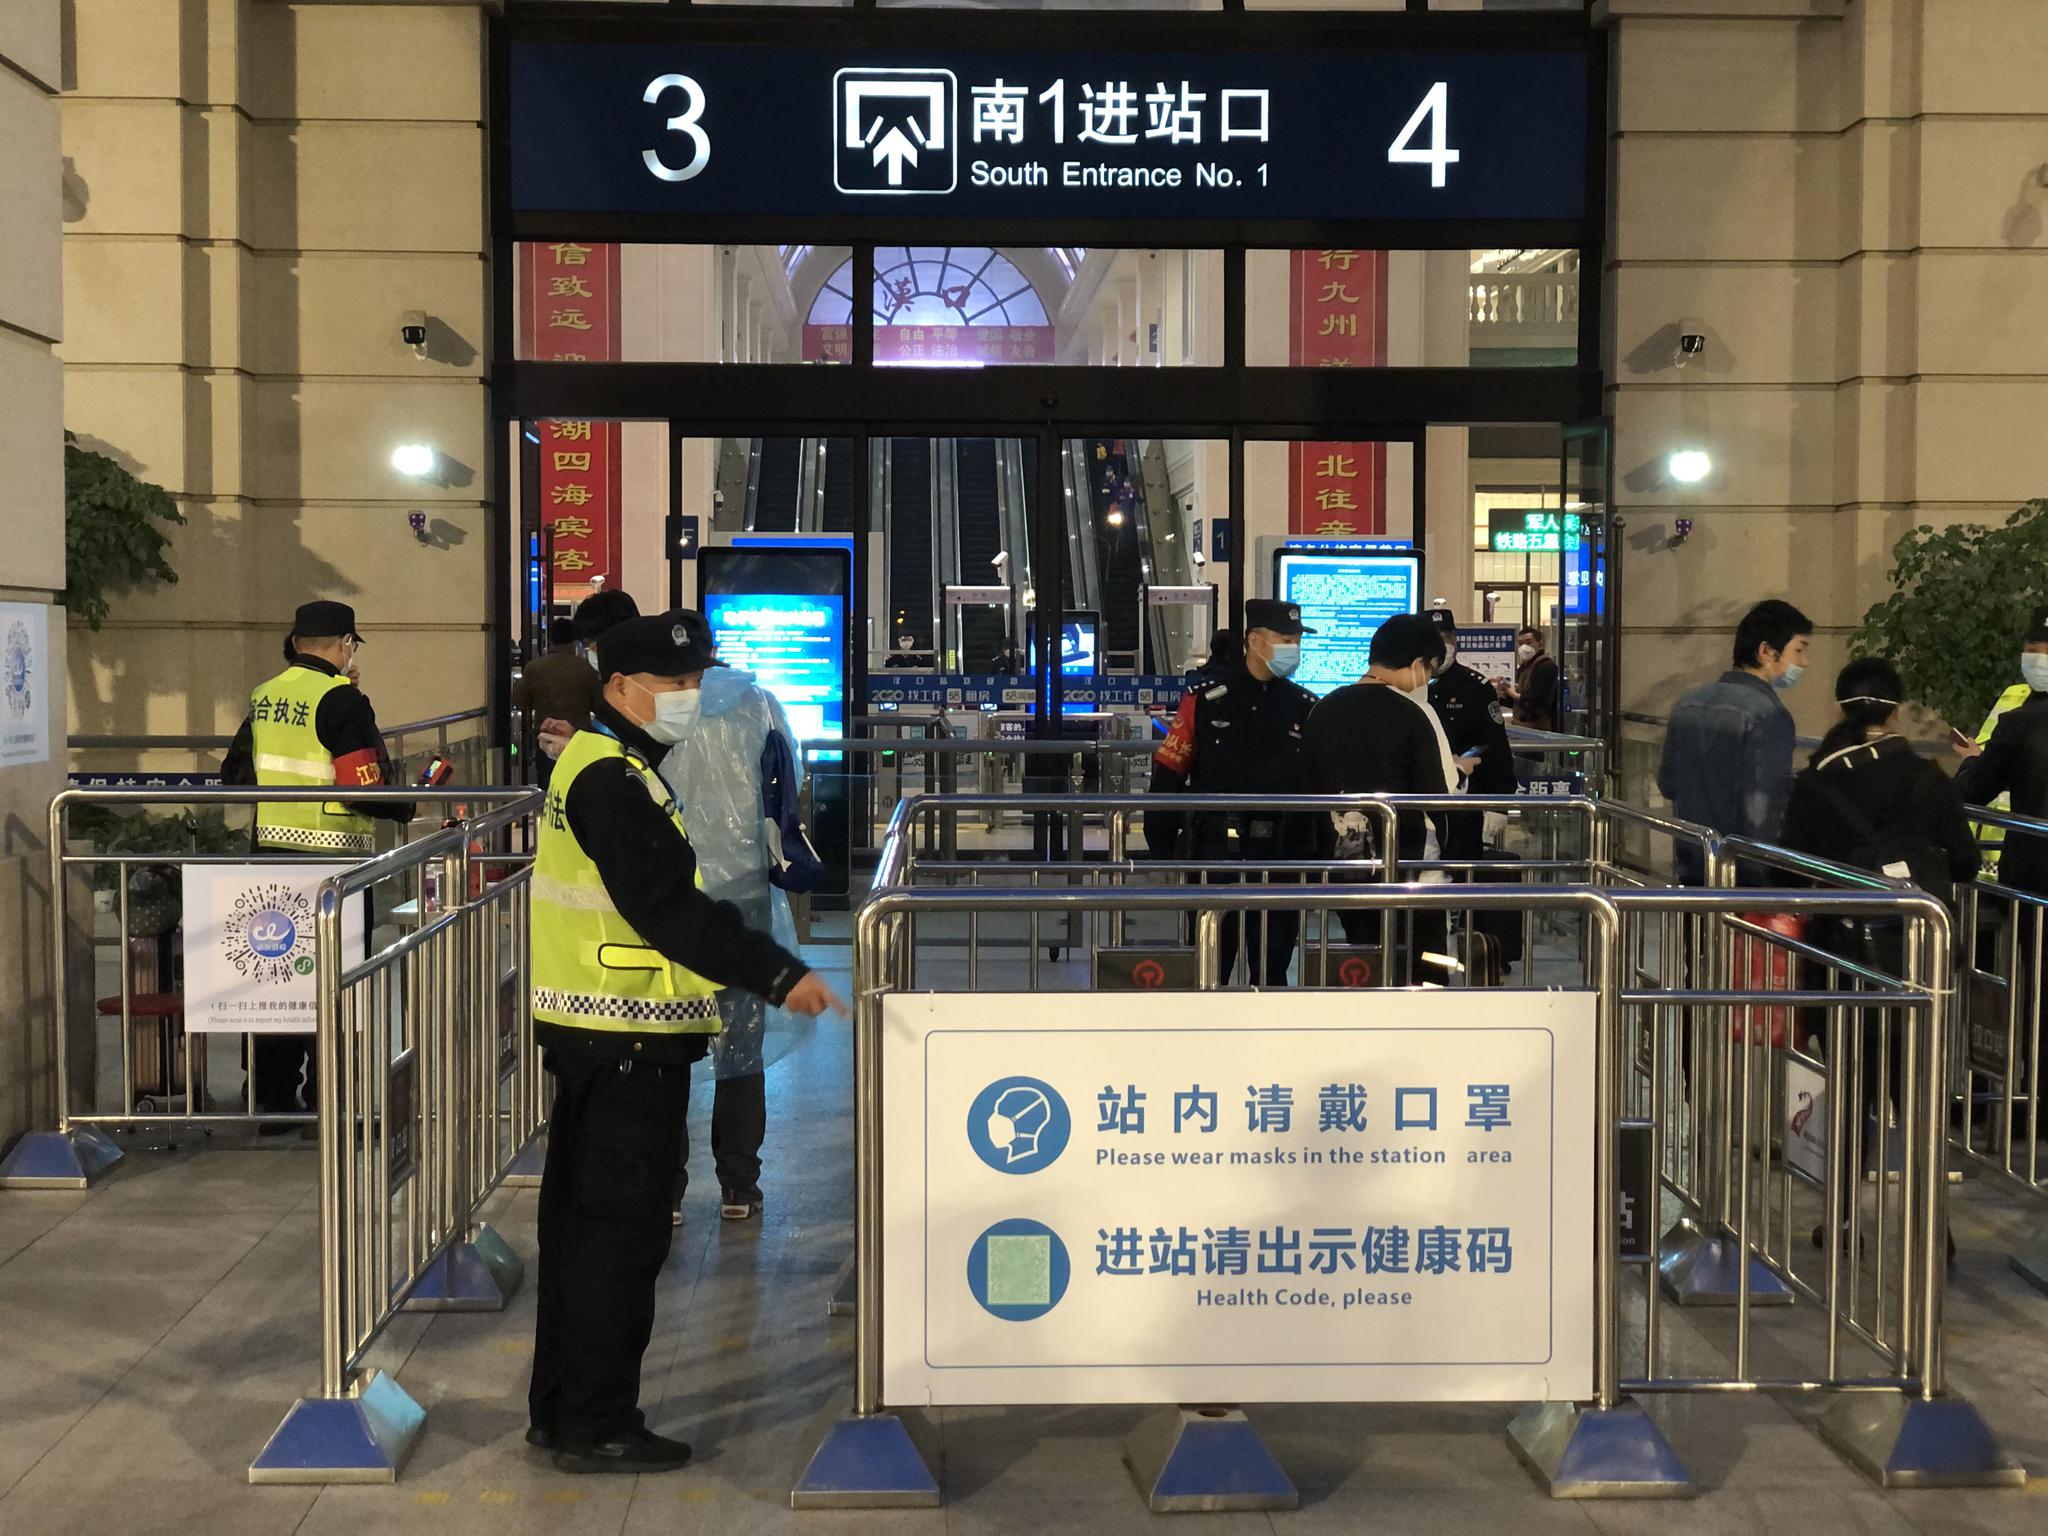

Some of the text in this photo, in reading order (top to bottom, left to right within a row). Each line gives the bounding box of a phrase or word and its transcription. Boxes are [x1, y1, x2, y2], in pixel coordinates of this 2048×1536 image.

[642, 73, 711, 182] 3
[970, 77, 1270, 146] 南1进站口
[1387, 81, 1460, 188] 4
[970, 160, 1268, 188] South Entrance No. 1
[908, 689, 943, 702] 找工作
[1100, 689, 1135, 702] 找工作
[1097, 1083, 1512, 1134] 站内请戴口罩
[1096, 1146, 1512, 1166] Please wear masks in the station area
[1095, 1225, 1513, 1276] 进站请出示健康码
[1197, 1287, 1412, 1310] Health Code, please
